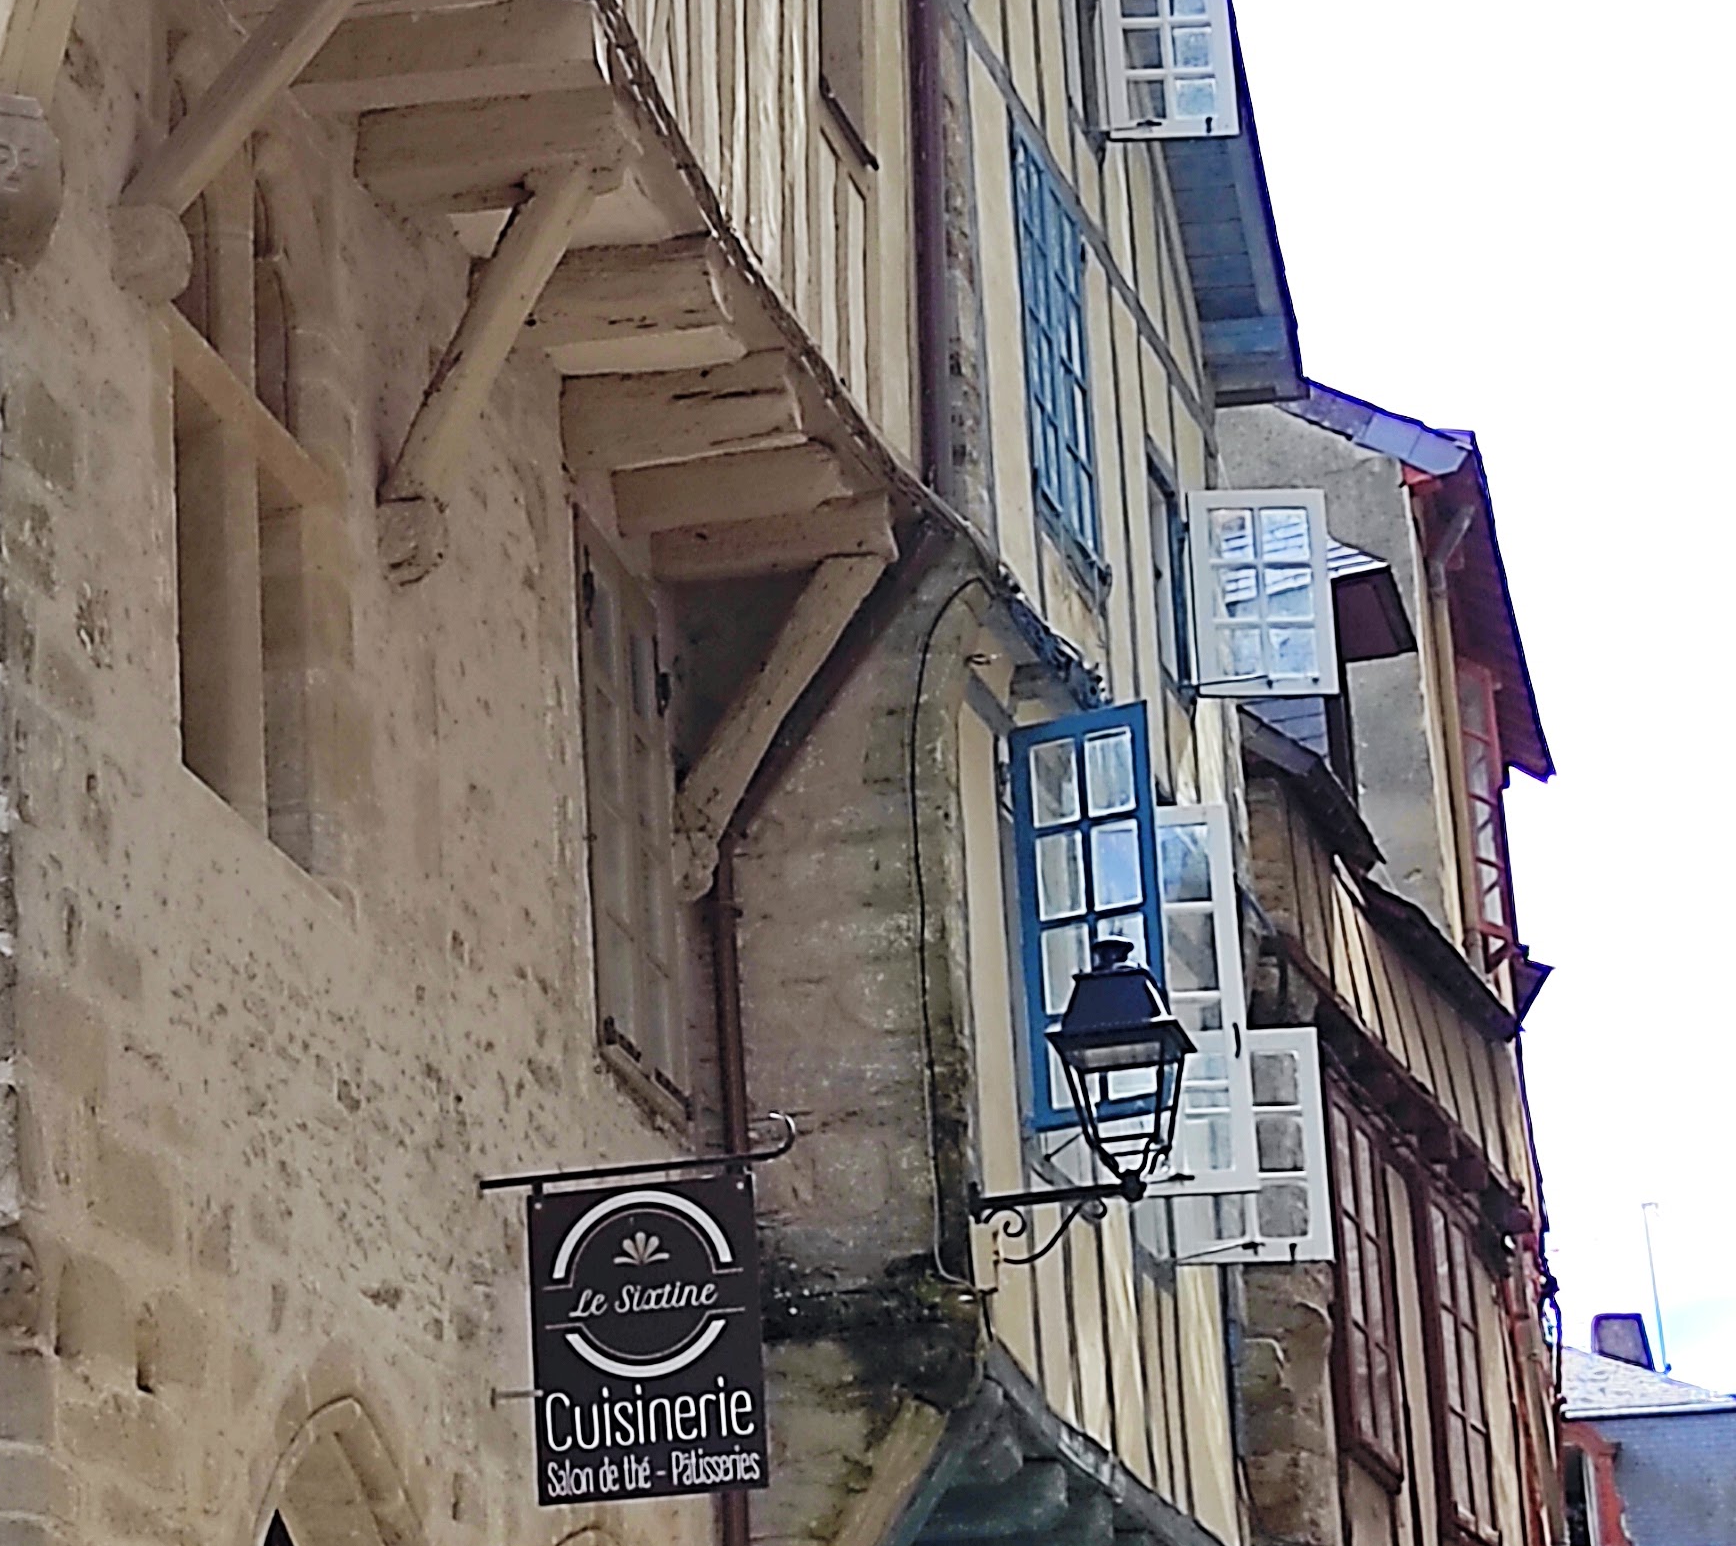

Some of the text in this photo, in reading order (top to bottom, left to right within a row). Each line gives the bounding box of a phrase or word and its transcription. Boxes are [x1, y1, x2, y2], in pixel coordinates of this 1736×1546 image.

[568, 1281, 719, 1318] Le Sixtine
[545, 1375, 755, 1452] Cuisinerie
[547, 1458, 595, 1497] Salon
[598, 1456, 620, 1493] de
[623, 1454, 652, 1490] thé
[671, 1443, 761, 1486] Pâtisseries
